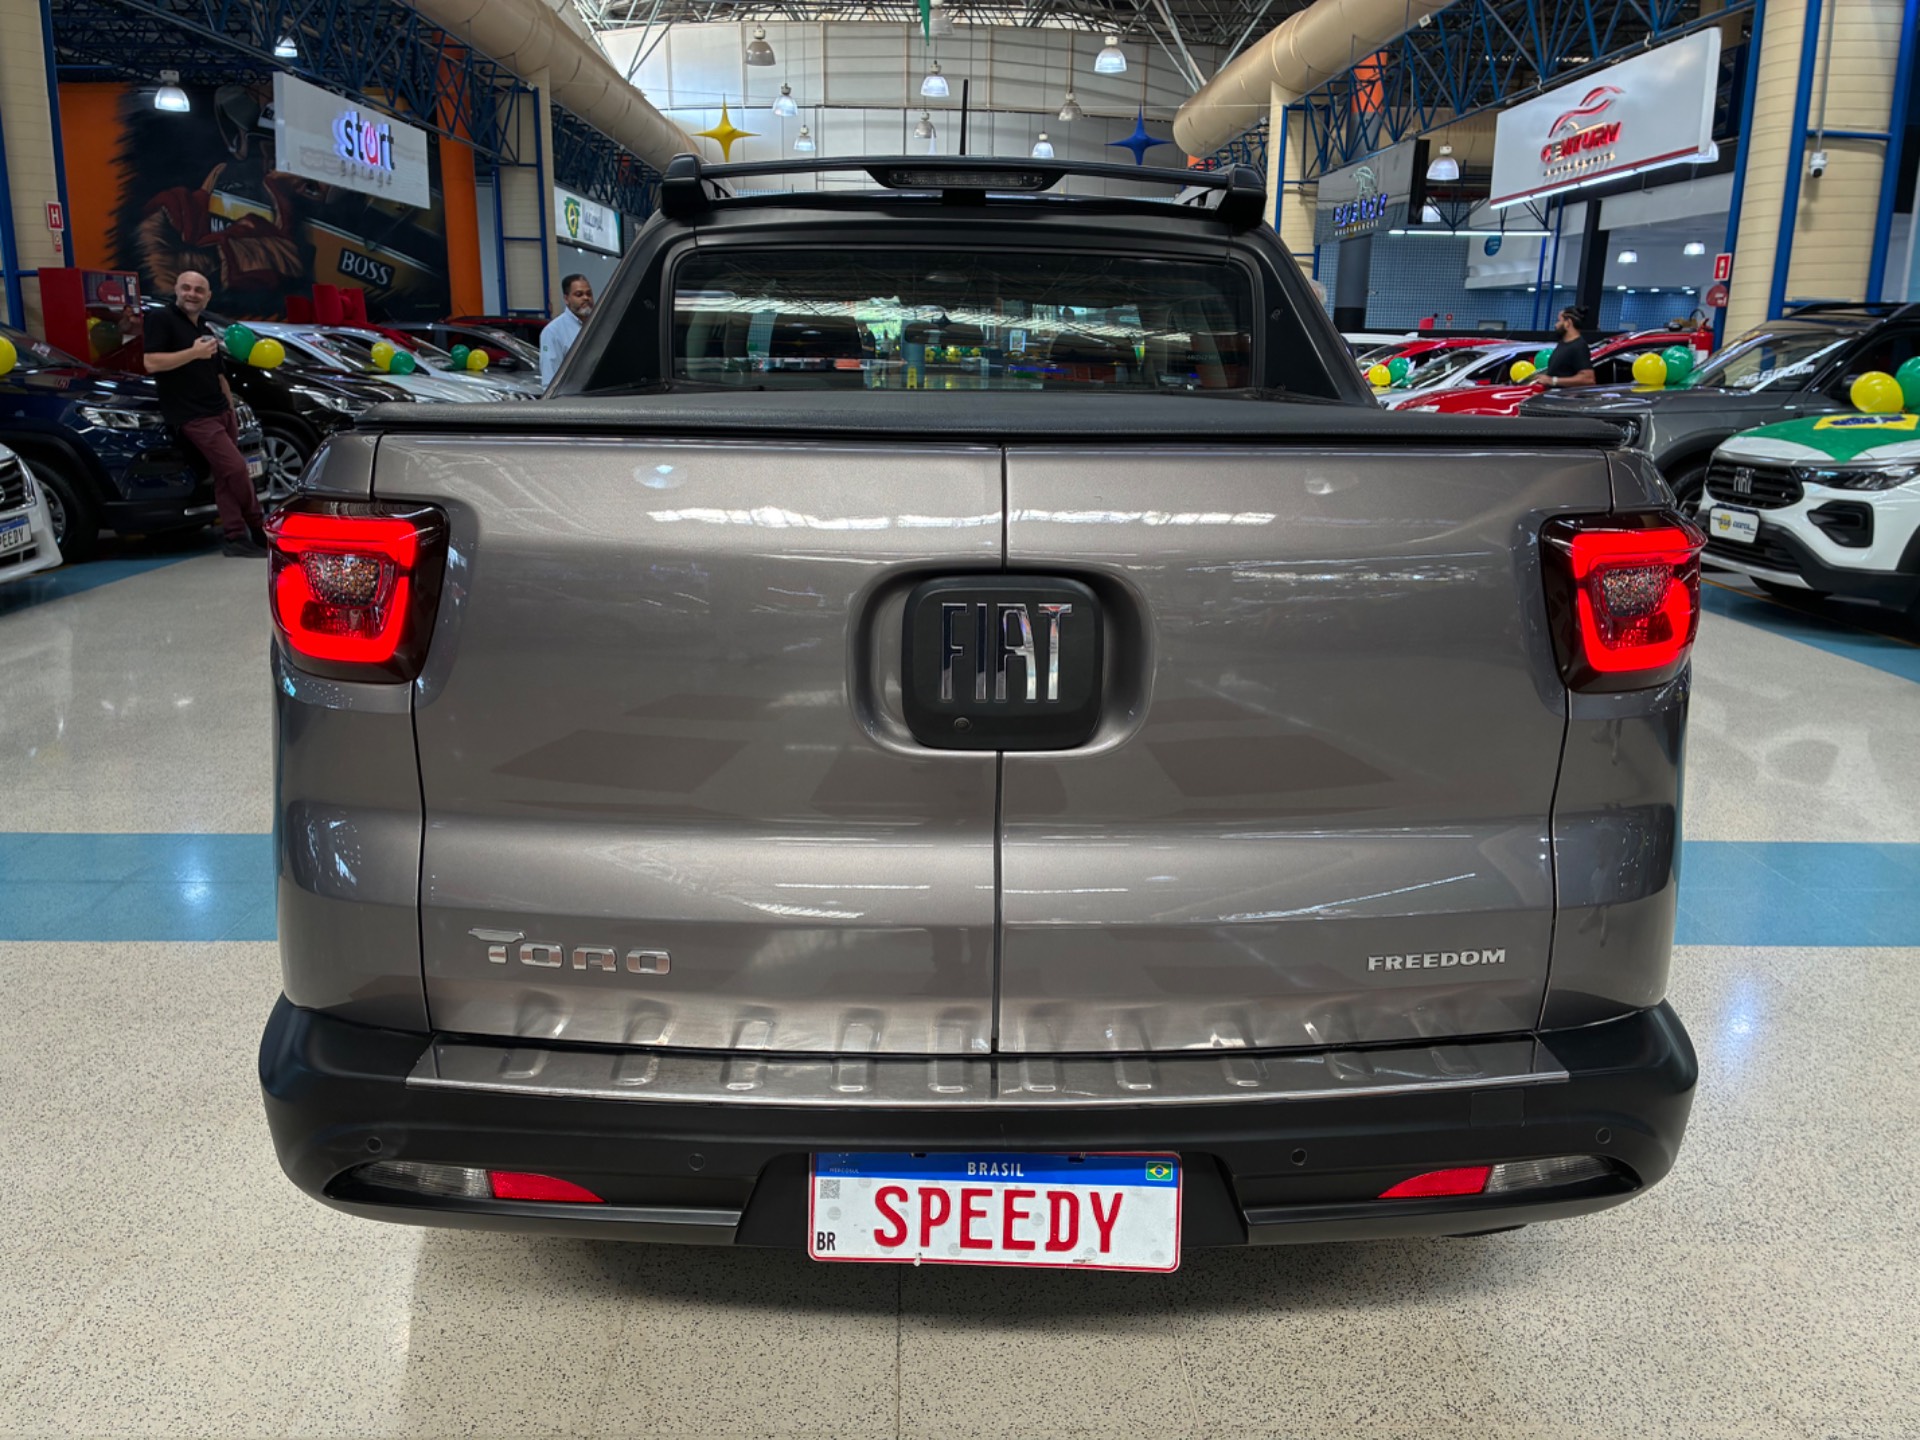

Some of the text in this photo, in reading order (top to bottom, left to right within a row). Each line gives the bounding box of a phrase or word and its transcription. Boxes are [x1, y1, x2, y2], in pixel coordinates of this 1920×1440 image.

[50, 207, 60, 226] H
[340, 250, 391, 286] BOSS
[941, 602, 1073, 700] FIAT
[468, 928, 672, 975] TORO
[1367, 948, 1506, 972] FREEDOM
[967, 1161, 1025, 1178] BRASIL
[873, 1185, 1124, 1254] SPEEDY
[816, 1231, 836, 1251] BR
